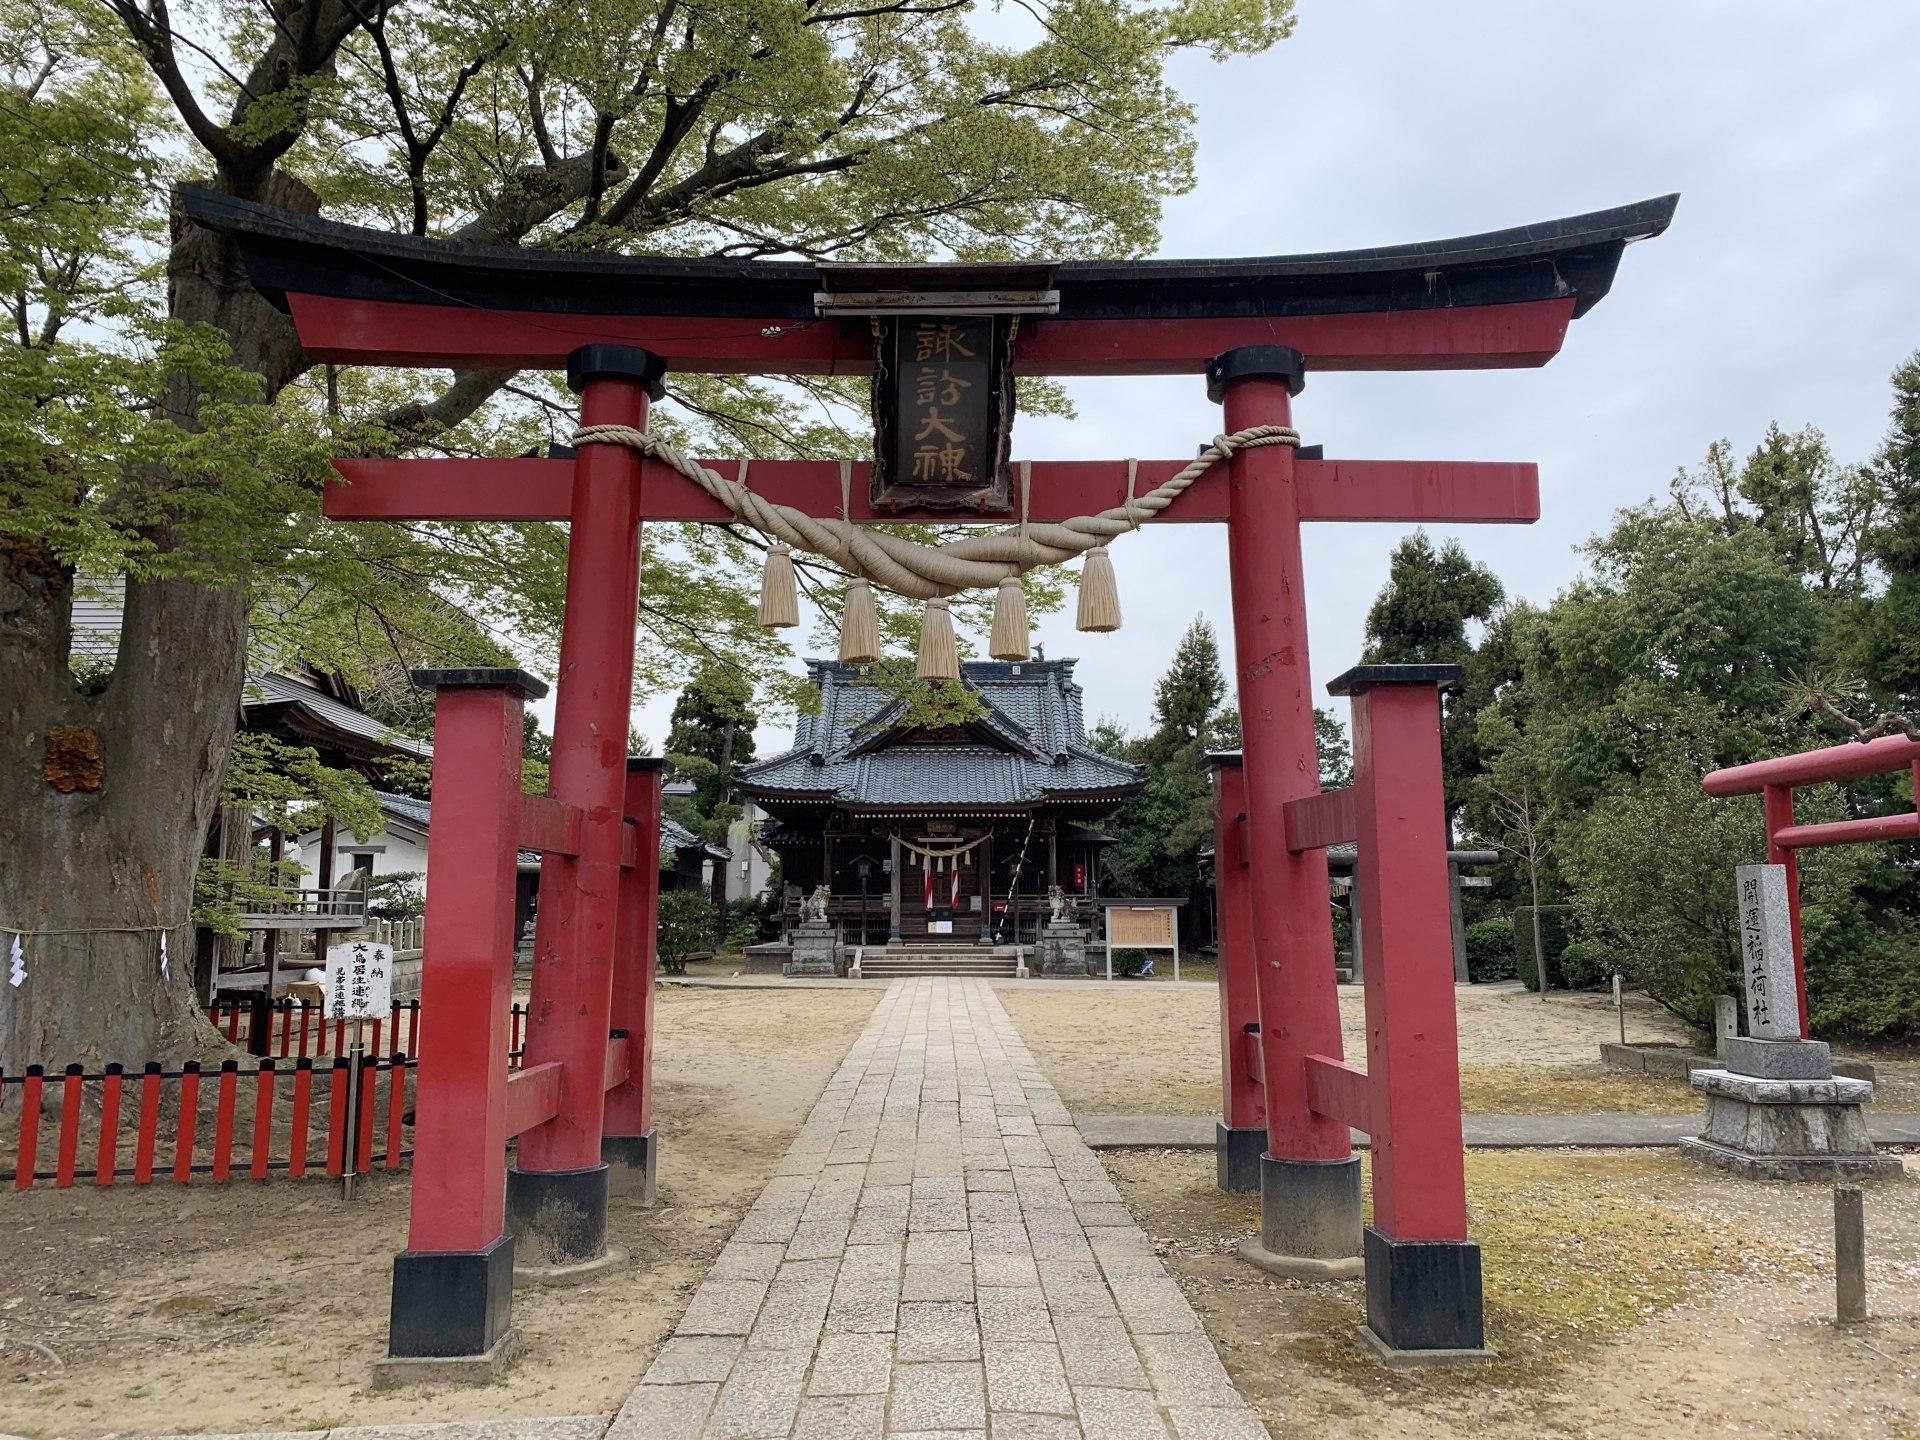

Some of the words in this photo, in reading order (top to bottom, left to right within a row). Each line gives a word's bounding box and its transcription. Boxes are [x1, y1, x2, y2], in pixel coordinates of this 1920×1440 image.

[912, 321, 976, 482] 諏訪大神
[371, 948, 386, 979] 奉納
[1742, 878, 1771, 1026] 開運稲荷社
